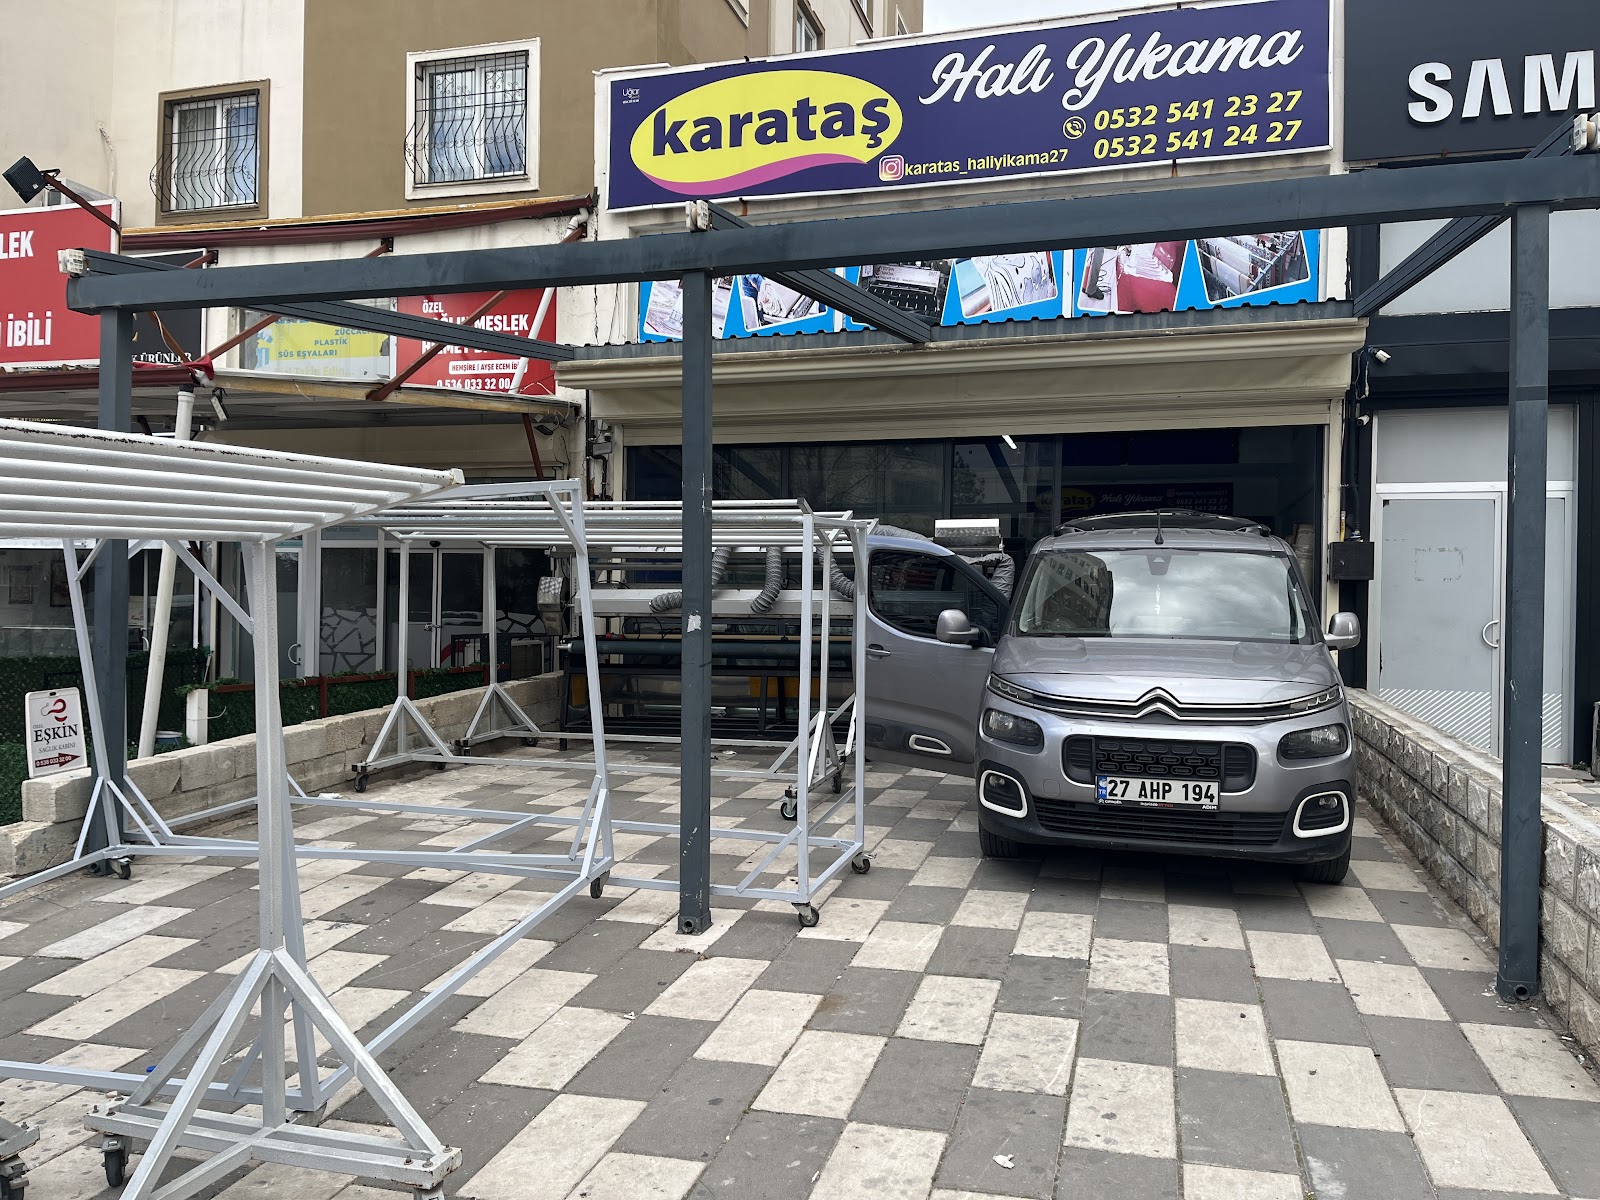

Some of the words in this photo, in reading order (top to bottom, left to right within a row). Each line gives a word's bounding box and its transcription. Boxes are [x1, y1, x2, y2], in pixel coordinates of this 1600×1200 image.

[919, 44, 1053, 105] Halı
[1062, 29, 1304, 111] Yıkama
[1408, 50, 1596, 123] SAM
[1094, 105, 1156, 131] 0532
[1166, 98, 1214, 123] 541
[1224, 94, 1258, 117] 23
[1268, 90, 1302, 113] 27
[653, 97, 891, 156] karataş
[1094, 134, 1156, 160] 0532
[1166, 127, 1214, 153] 541
[1223, 124, 1258, 148] 24
[1267, 119, 1302, 143] 27
[904, 149, 1069, 176] karatas_haliyikama27
[422, 300, 444, 313] ÖZEL
[6, 311, 52, 347] İBİLİ
[474, 314, 529, 331] MESLEK
[278, 350, 294, 358] SÜS
[297, 349, 338, 358] EŞYALARI
[314, 338, 348, 346] PLASTİK
[452, 362, 476, 371] HEMŞİRE
[480, 363, 495, 371] AYŞE
[496, 362, 511, 370] ECEM
[445, 379, 463, 389] 536
[465, 379, 481, 390] 033
[484, 378, 497, 389] 32
[499, 378, 511, 389] 00
[34, 722, 78, 745] EŞKİN
[1108, 780, 1130, 797] 27
[1138, 781, 1172, 800] AHP
[1182, 783, 1215, 803] 194
